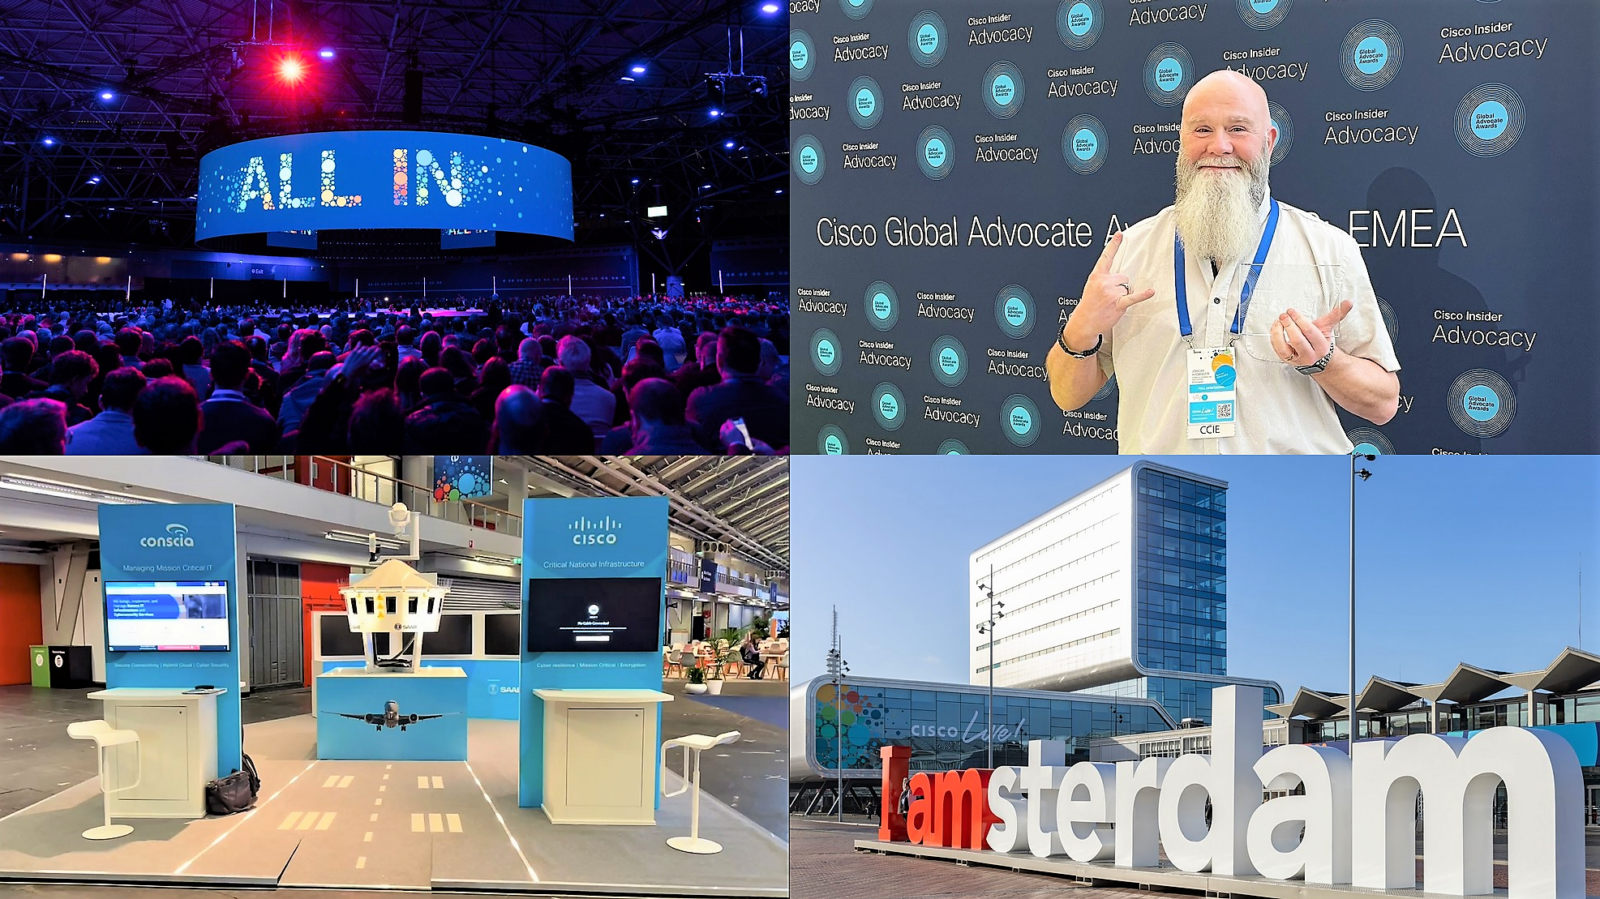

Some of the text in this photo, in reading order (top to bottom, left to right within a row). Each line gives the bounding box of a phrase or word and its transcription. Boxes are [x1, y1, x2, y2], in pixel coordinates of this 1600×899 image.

[968, 14, 1011, 26] Cisco Insider
[1129, 4, 1208, 26] Advocacy
[968, 26, 1033, 46] Advocacy
[1440, 22, 1512, 38] Cisco Insider
[833, 33, 870, 44] Cisco Insider
[834, 45, 888, 62] Advocacy
[1223, 47, 1280, 61] Cisco Insider
[1438, 37, 1548, 64] Advocacy
[1048, 66, 1094, 78] Cisco Insider
[1225, 62, 1308, 81] dvocacy
[902, 82, 941, 92] Cisco Insider
[1048, 80, 1118, 98] Advocacy
[903, 94, 961, 111] Advocacy
[1325, 109, 1388, 122] Cisco Insider
[1133, 123, 1180, 134] Cisco Inside
[1324, 126, 1418, 145] Advocacy
[975, 133, 1017, 144] Cisco Insider
[844, 154, 897, 169] Advocacy
[976, 147, 1038, 163] Advocacy
[236, 148, 466, 213] ALL IN
[817, 217, 878, 247] Cisco
[885, 216, 958, 247] Global
[968, 216, 1092, 247] Advocate
[1350, 208, 1468, 247] EMEA
[799, 298, 847, 316] Advocacy
[1058, 297, 1077, 305] Cisco
[918, 303, 974, 322] Advocacy
[1434, 310, 1503, 321] Cisco Insider
[859, 340, 874, 348] Cisco
[1432, 325, 1536, 351] Advocacy
[859, 351, 912, 370] Advocacy
[988, 348, 1028, 359] Cisco Insider
[988, 360, 1048, 381] Advocacy
[806, 394, 855, 414] Advocacy
[924, 395, 961, 406] Cisco Insider
[924, 406, 980, 428] Advocacy
[1063, 410, 1107, 421] Cisco Insider
[1200, 425, 1220, 434] CCIE
[866, 438, 900, 449] Cisco Insider
[140, 534, 194, 547] conscia
[573, 534, 617, 545] CISCO
[911, 710, 1025, 744] CISCO Live!
